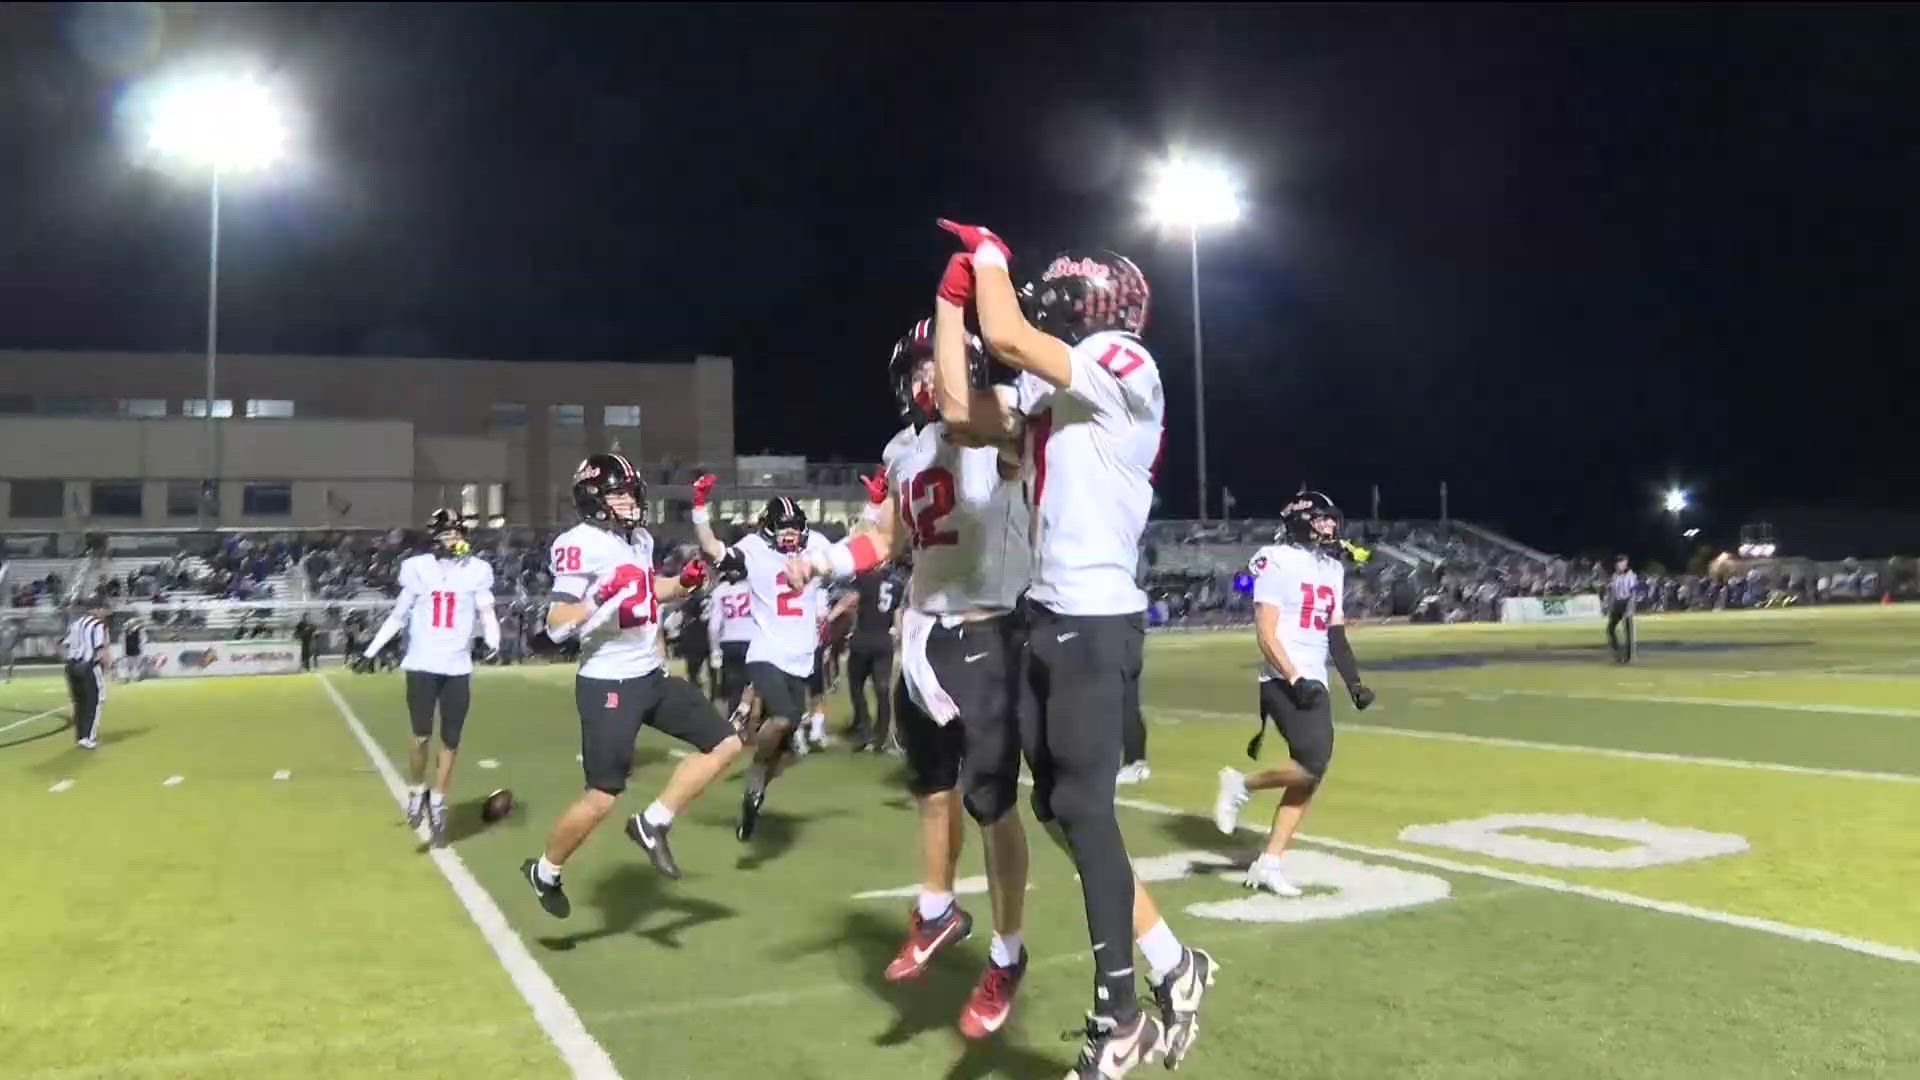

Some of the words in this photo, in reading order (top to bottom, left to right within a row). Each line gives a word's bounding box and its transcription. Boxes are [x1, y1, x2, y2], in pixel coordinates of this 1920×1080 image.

[1097, 343, 1145, 378] 17
[901, 466, 959, 548] 12
[554, 546, 582, 572] 28
[431, 590, 456, 628] 11
[720, 592, 751, 618] 52
[776, 570, 803, 616] 2
[877, 580, 893, 612] 5
[1300, 582, 1336, 631] 13
